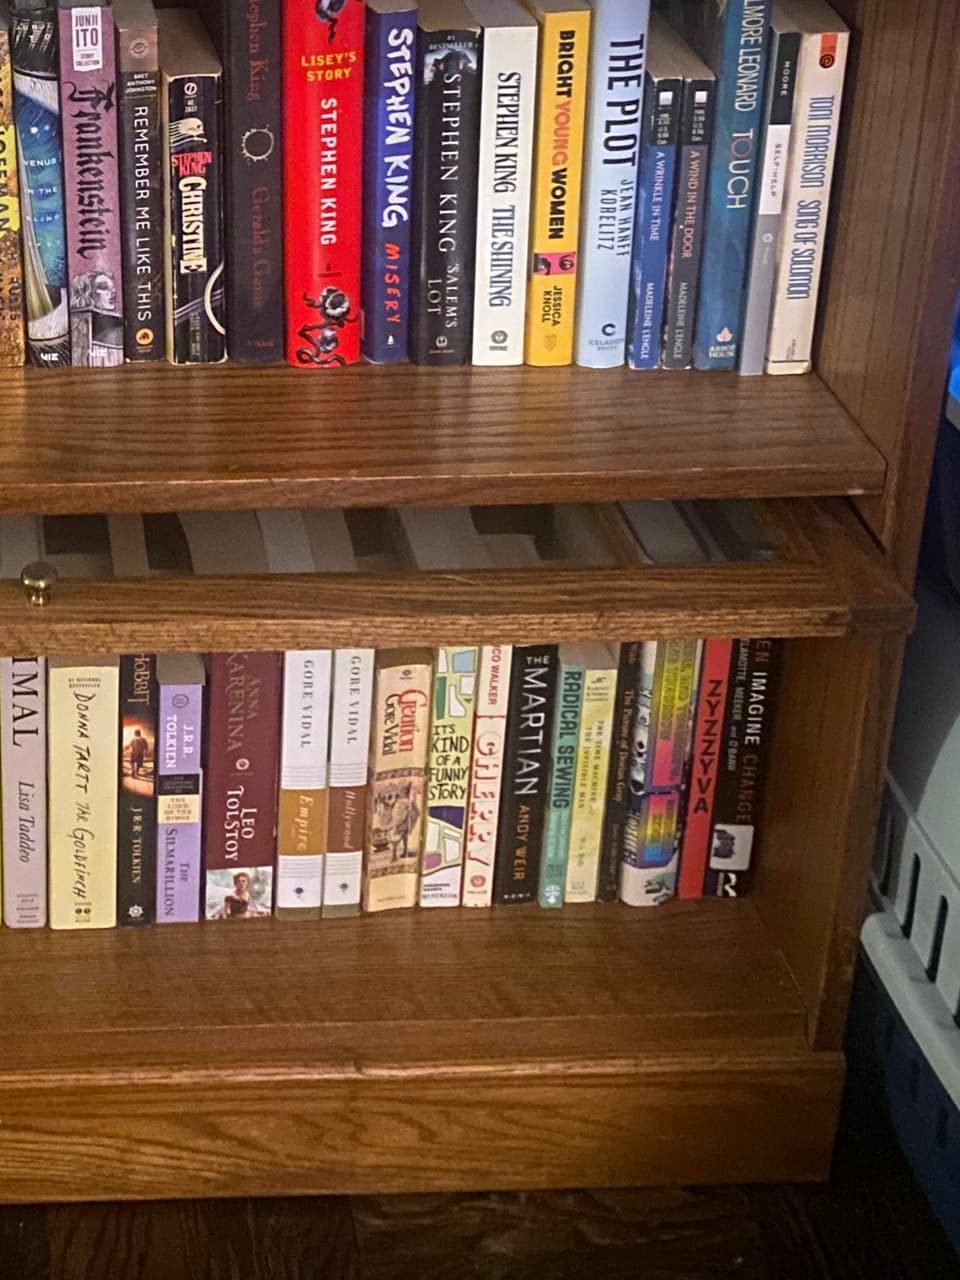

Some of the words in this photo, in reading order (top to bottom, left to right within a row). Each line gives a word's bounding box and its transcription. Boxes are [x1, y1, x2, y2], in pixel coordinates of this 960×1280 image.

[75, 14, 98, 28] JUNJI
[76, 28, 99, 48] ITO
[247, 59, 266, 100] King
[306, 71, 352, 81] STORY
[557, 30, 575, 98] BRIGHT
[607, 34, 644, 90] THE
[781, 61, 791, 96] MOORE
[383, 28, 413, 145] STEPHEN
[440, 72, 462, 181] STEPHEN
[495, 72, 521, 150] STEPHEN
[553, 100, 572, 166] YOUNG
[602, 100, 639, 166] PLOT
[134, 106, 149, 200] REMEMBER
[320, 98, 337, 191] STEPHEN
[382, 155, 408, 227] KING
[493, 153, 517, 193] KING
[136, 207, 149, 230] ME
[320, 197, 337, 245] KING
[438, 193, 456, 252] KING
[491, 205, 515, 239] THE
[548, 168, 567, 239] WOMEN
[136, 238, 150, 275] LIKE
[489, 241, 514, 307] SHINING
[137, 281, 151, 320] THIS
[384, 243, 401, 323] MISERY
[246, 677, 261, 719] ANNA
[349, 656, 361, 695] GORE
[347, 702, 360, 744] VIDAL
[384, 693, 398, 724] Gore
[396, 689, 428, 752] Creation
[559, 671, 582, 739] RADICAL
[745, 672, 767, 745] IMAGINE
[165, 715, 177, 768] TOLKIEN
[183, 724, 193, 758] J.R.R.
[382, 725, 397, 756] Vidal
[431, 737, 469, 752] KIND
[514, 667, 549, 795] MARTIAN
[19, 781, 34, 812] Lisa
[425, 768, 469, 781] FUNNY
[427, 784, 466, 800] STORY
[552, 745, 575, 809] SEWING
[19, 816, 34, 863] Taddeo
[342, 790, 356, 850] Hollywood
[516, 805, 530, 841] ANDY
[132, 840, 141, 883] TOLKIEN
[513, 847, 526, 880] WEIR
